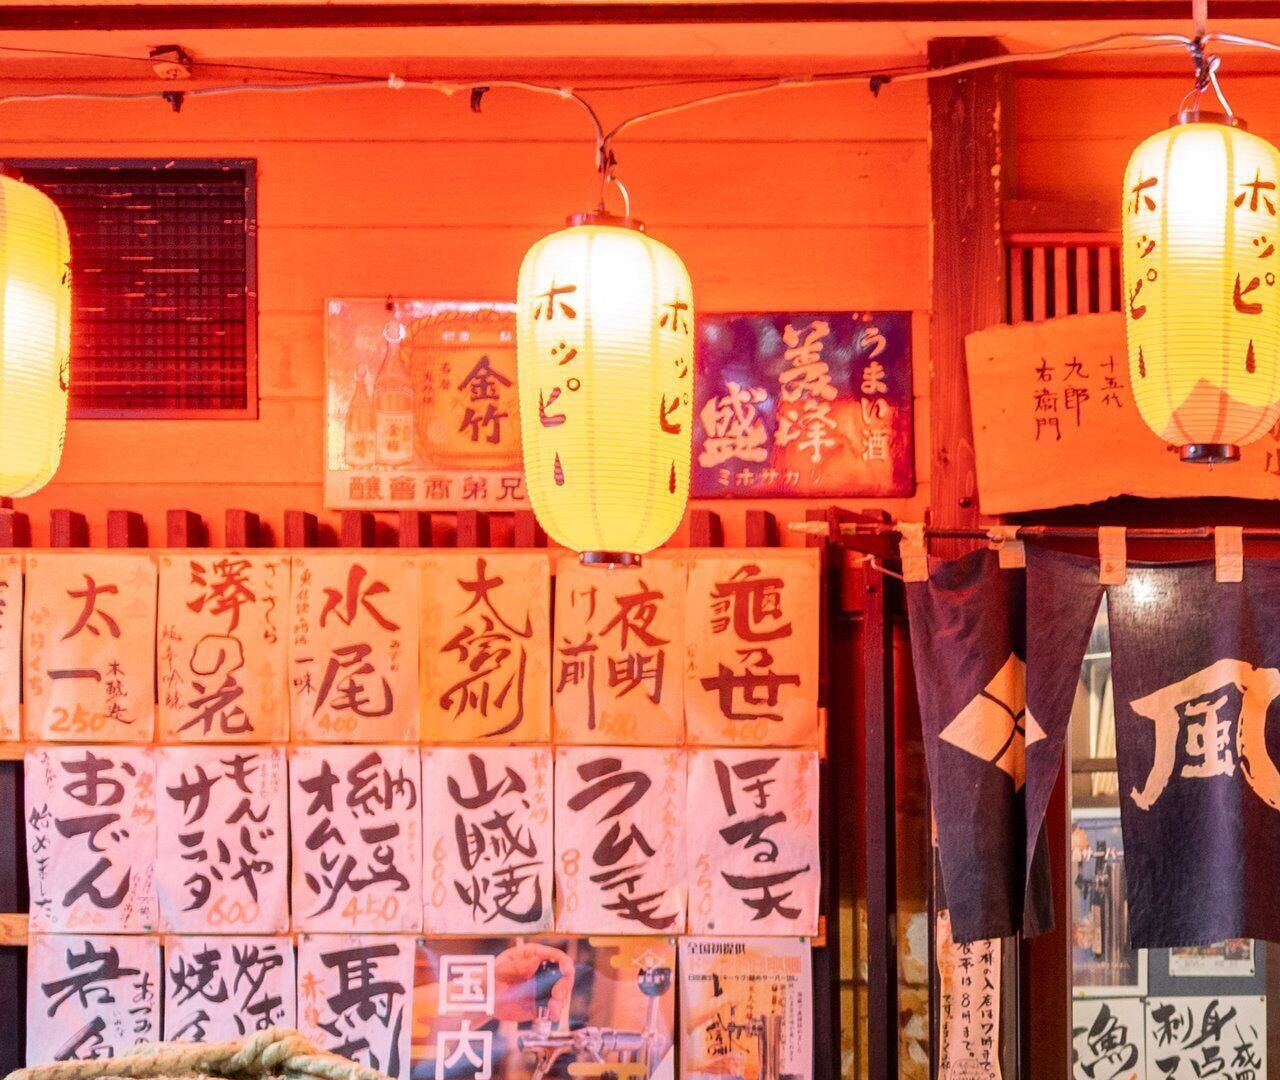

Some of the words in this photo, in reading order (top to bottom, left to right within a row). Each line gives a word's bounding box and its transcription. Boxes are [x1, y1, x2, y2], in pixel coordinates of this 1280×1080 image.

[1127, 170, 1159, 379] ホッピー
[1233, 166, 1279, 374] ホッピー
[458, 354, 513, 446] 金竹
[534, 275, 582, 487] ホッピー
[660, 287, 695, 495] ホッピー
[860, 326, 890, 462] うまい酒
[47, 573, 122, 683] 太一
[176, 558, 256, 736] 澤の花
[312, 563, 401, 720] 水尾
[55, 750, 137, 909] おでん
[447, 753, 545, 925] 山賊焼
[206, 897, 261, 927] 600
[341, 895, 400, 924] 450
